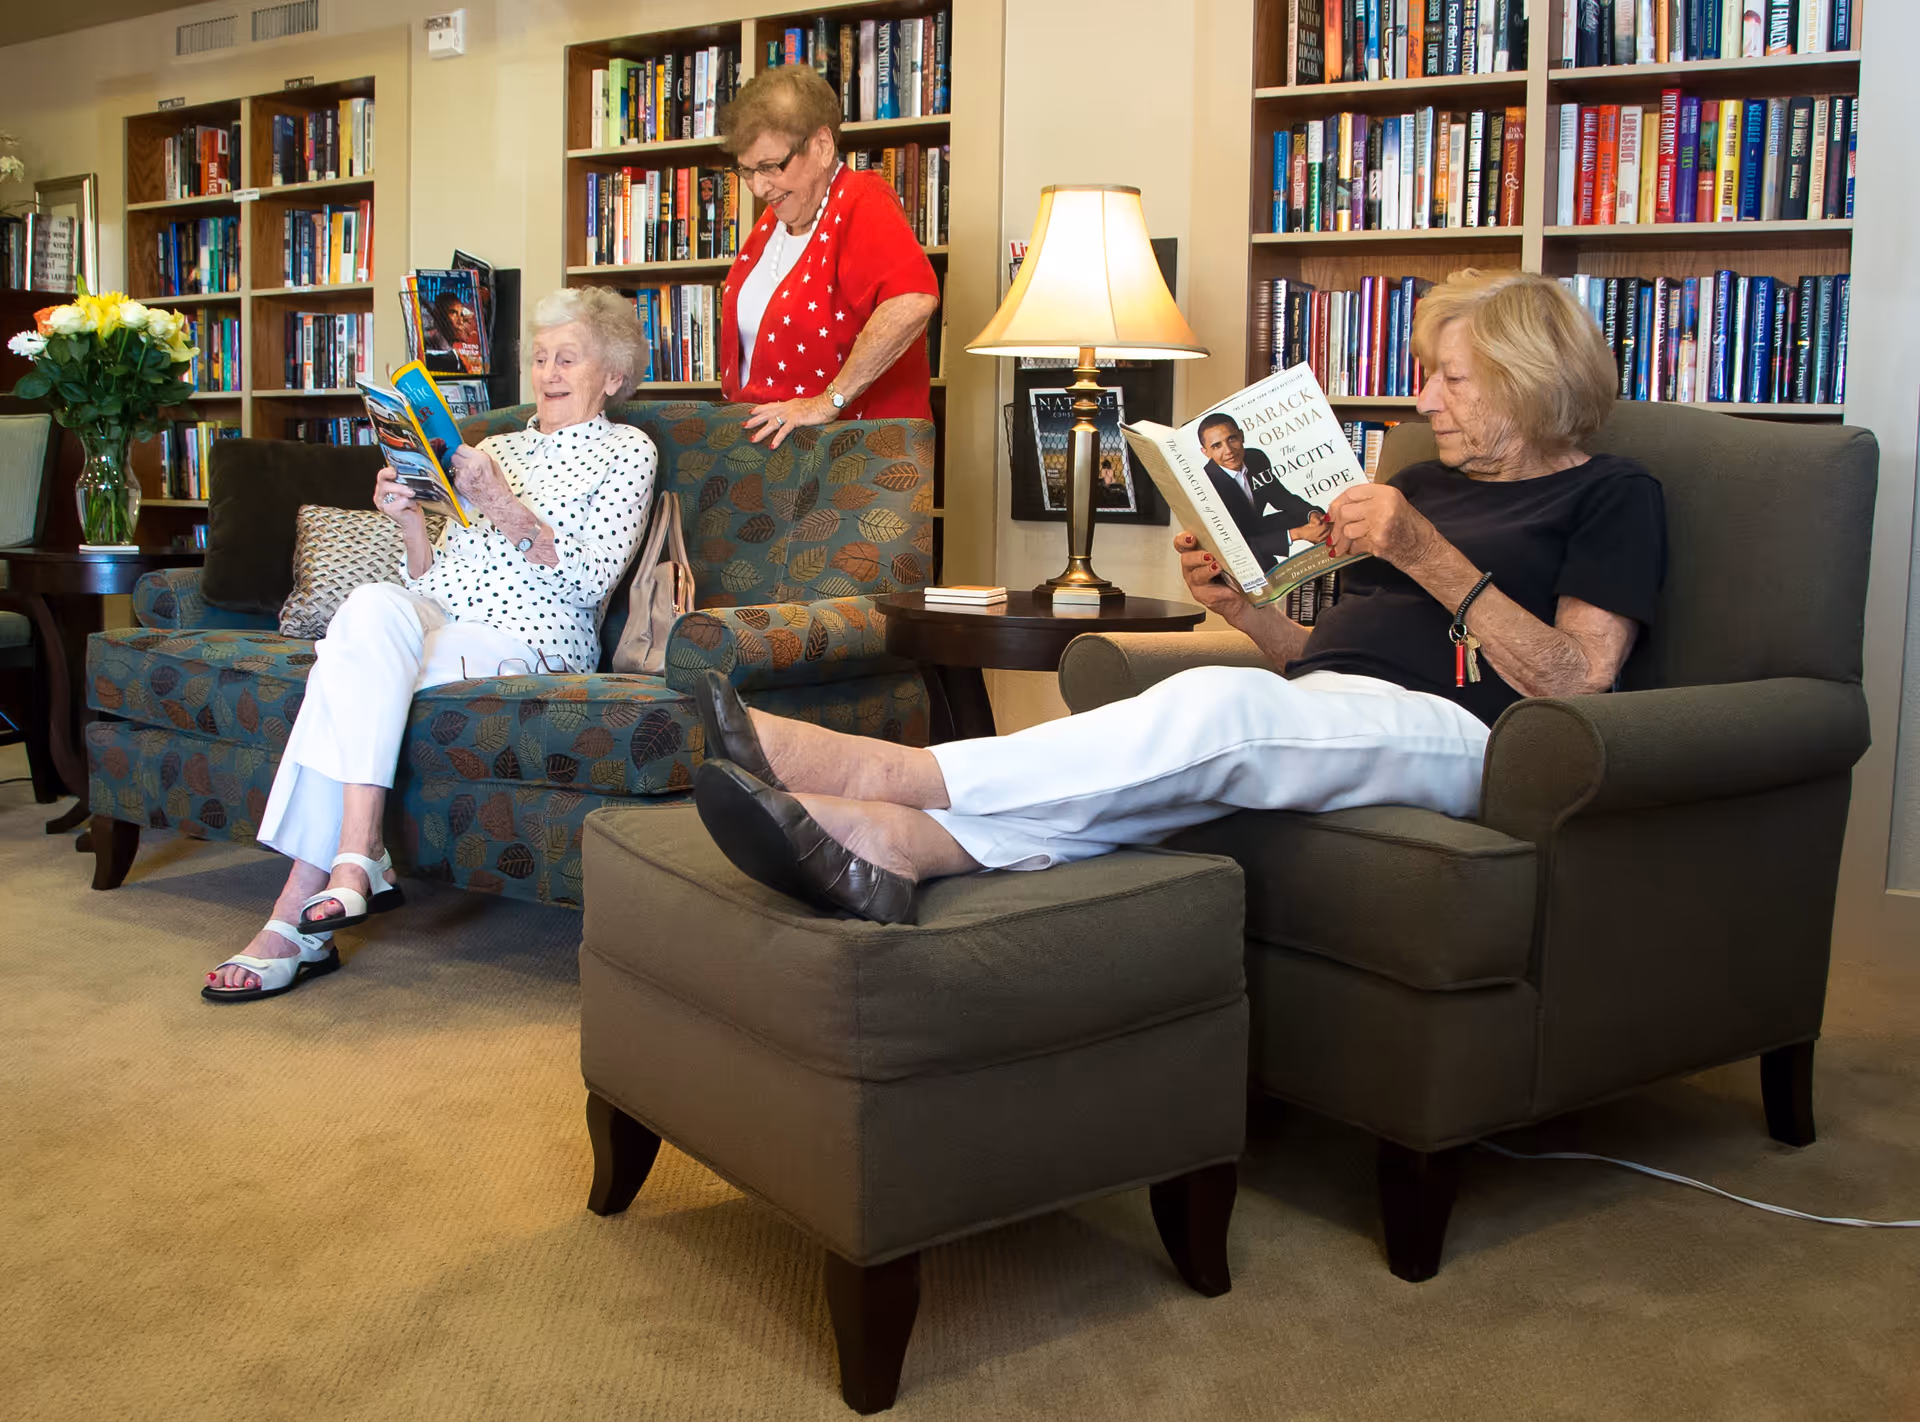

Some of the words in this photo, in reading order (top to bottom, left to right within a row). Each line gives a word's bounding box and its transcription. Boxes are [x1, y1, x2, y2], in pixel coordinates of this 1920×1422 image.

[1448, 3, 1459, 25] Four
[1447, 25, 1458, 49] Blind
[1770, 9, 1790, 51] FRANZEN
[1446, 49, 1457, 72] Mice
[1661, 94, 1677, 115] DICK
[1793, 108, 1809, 128] WILD
[1659, 117, 1676, 155] FRANCIS
[1747, 104, 1762, 143] DECIDER
[1582, 135, 1597, 172] FRANCIS
[1621, 113, 1638, 166] LONGSHOT
[1790, 129, 1808, 157] HORSES
[857, 152, 868, 170] JOHN
[1681, 146, 1694, 169] SILKS
[1722, 184, 1733, 205] FRANCI
[1607, 279, 1617, 299] SUE
[1628, 281, 1636, 297] SUE
[1606, 298, 1615, 348] GRAFTON
[1626, 297, 1634, 336] GRAFTON
[1716, 291, 1726, 332] GRAFTON
[1801, 297, 1810, 337] GRAFTON
[1622, 363, 1632, 394] Trespass
[1796, 365, 1806, 397] Trespass
[1038, 396, 1115, 411] NATRE
[1242, 387, 1315, 432] BARACK
[1258, 408, 1323, 446] OBAMA
[1352, 425, 1363, 454] JACKIE
[1251, 440, 1338, 491] AUDACITY
[1279, 444, 1296, 457] The
[1303, 468, 1355, 500] HOPE
[1305, 469, 1315, 482] of
[1165, 438, 1177, 453] The
[1174, 452, 1209, 505] AUDACITY
[1204, 505, 1213, 515] of
[1211, 516, 1232, 544] HOPE
[1300, 591, 1315, 621] CORNWELL
